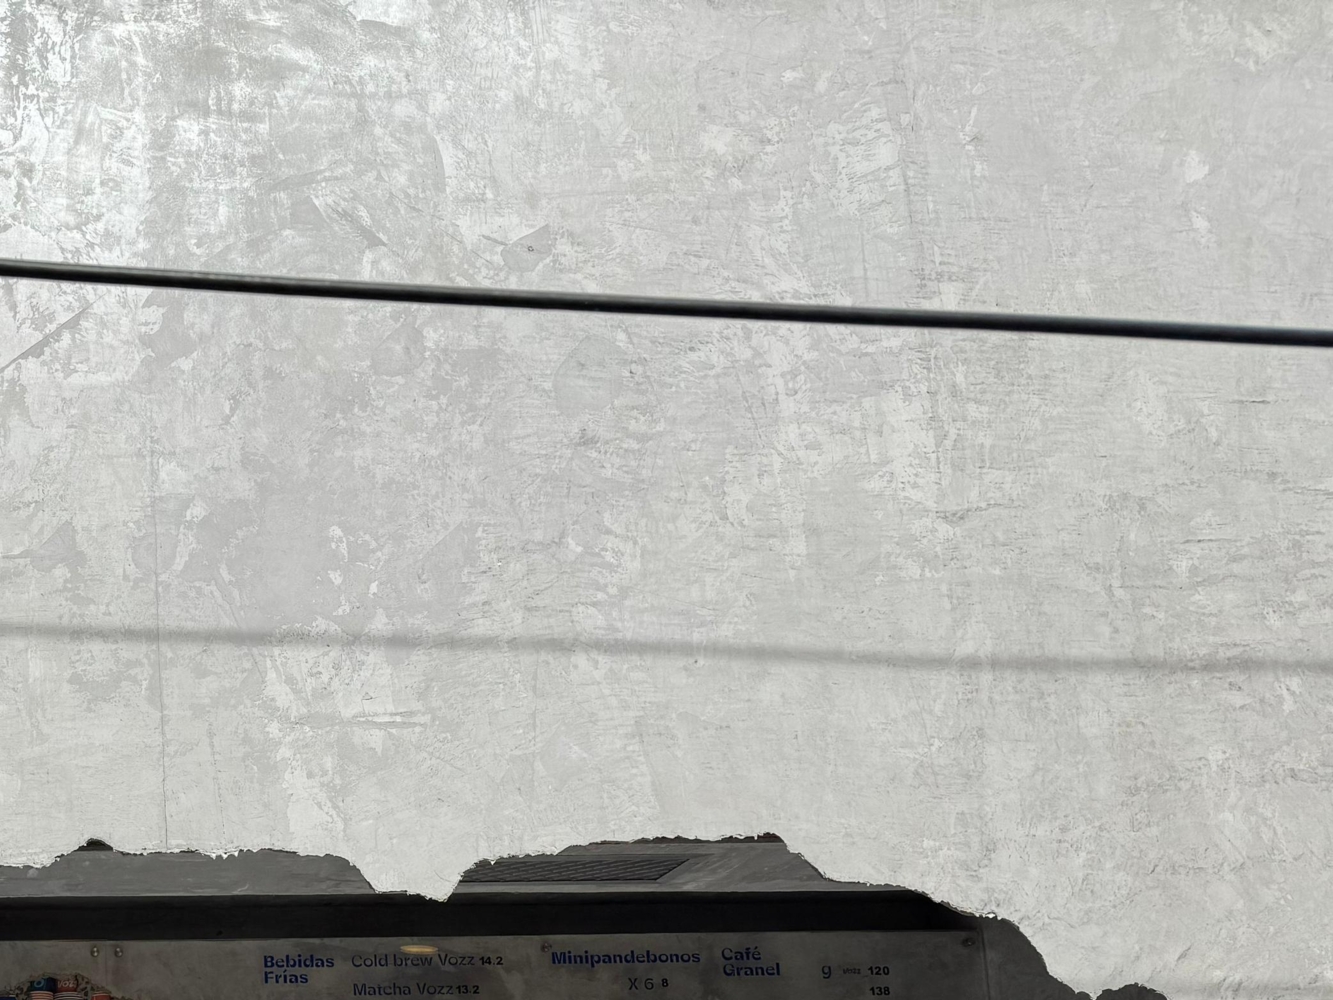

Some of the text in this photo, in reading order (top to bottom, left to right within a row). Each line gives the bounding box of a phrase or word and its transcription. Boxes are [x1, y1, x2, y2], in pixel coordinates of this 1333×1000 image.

[551, 950, 700, 968] Minipandebonos
[722, 946, 762, 961] Café
[264, 954, 335, 968] Bebidas
[351, 953, 503, 968] Cold brew Vozz 14.2
[723, 963, 781, 976] Granel
[822, 966, 831, 979] g
[868, 966, 889, 976] 120
[264, 969, 309, 984] Frías
[353, 983, 480, 996] Matcha Vozz 13.2
[629, 978, 668, 990] X 6 8
[870, 986, 890, 996] 138
